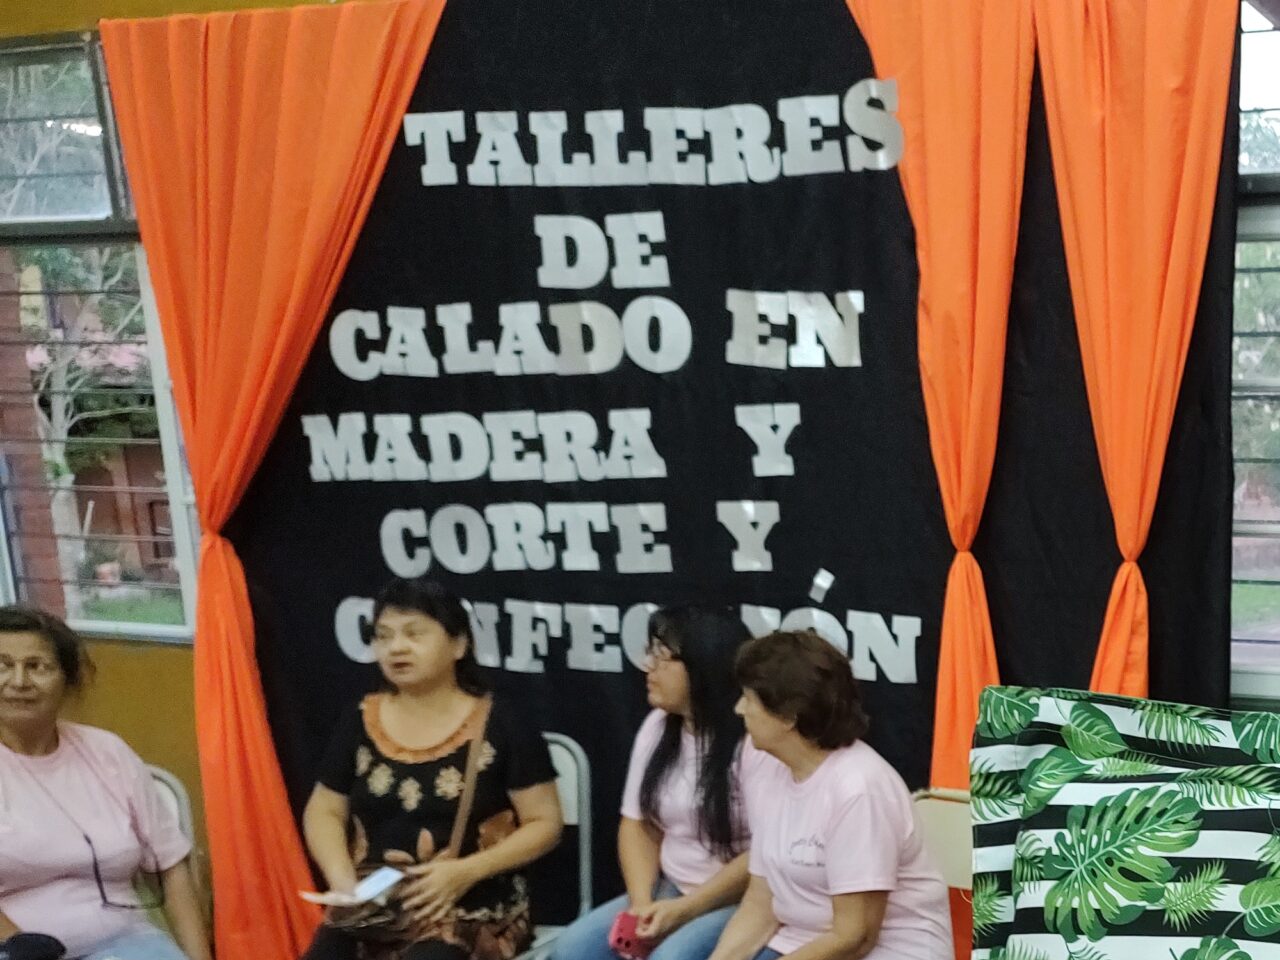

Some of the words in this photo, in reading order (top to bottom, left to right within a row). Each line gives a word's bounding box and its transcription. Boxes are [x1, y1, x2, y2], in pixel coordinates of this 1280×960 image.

[404, 78, 903, 187] TALLERES
[533, 211, 671, 290] DE
[329, 296, 692, 381] CALADO
[725, 288, 865, 370] EN
[301, 408, 667, 483] MADERA
[735, 402, 801, 477] Y
[380, 501, 673, 578] CORTE
[716, 500, 781, 571] Y
[335, 568, 922, 684] CNFECN
